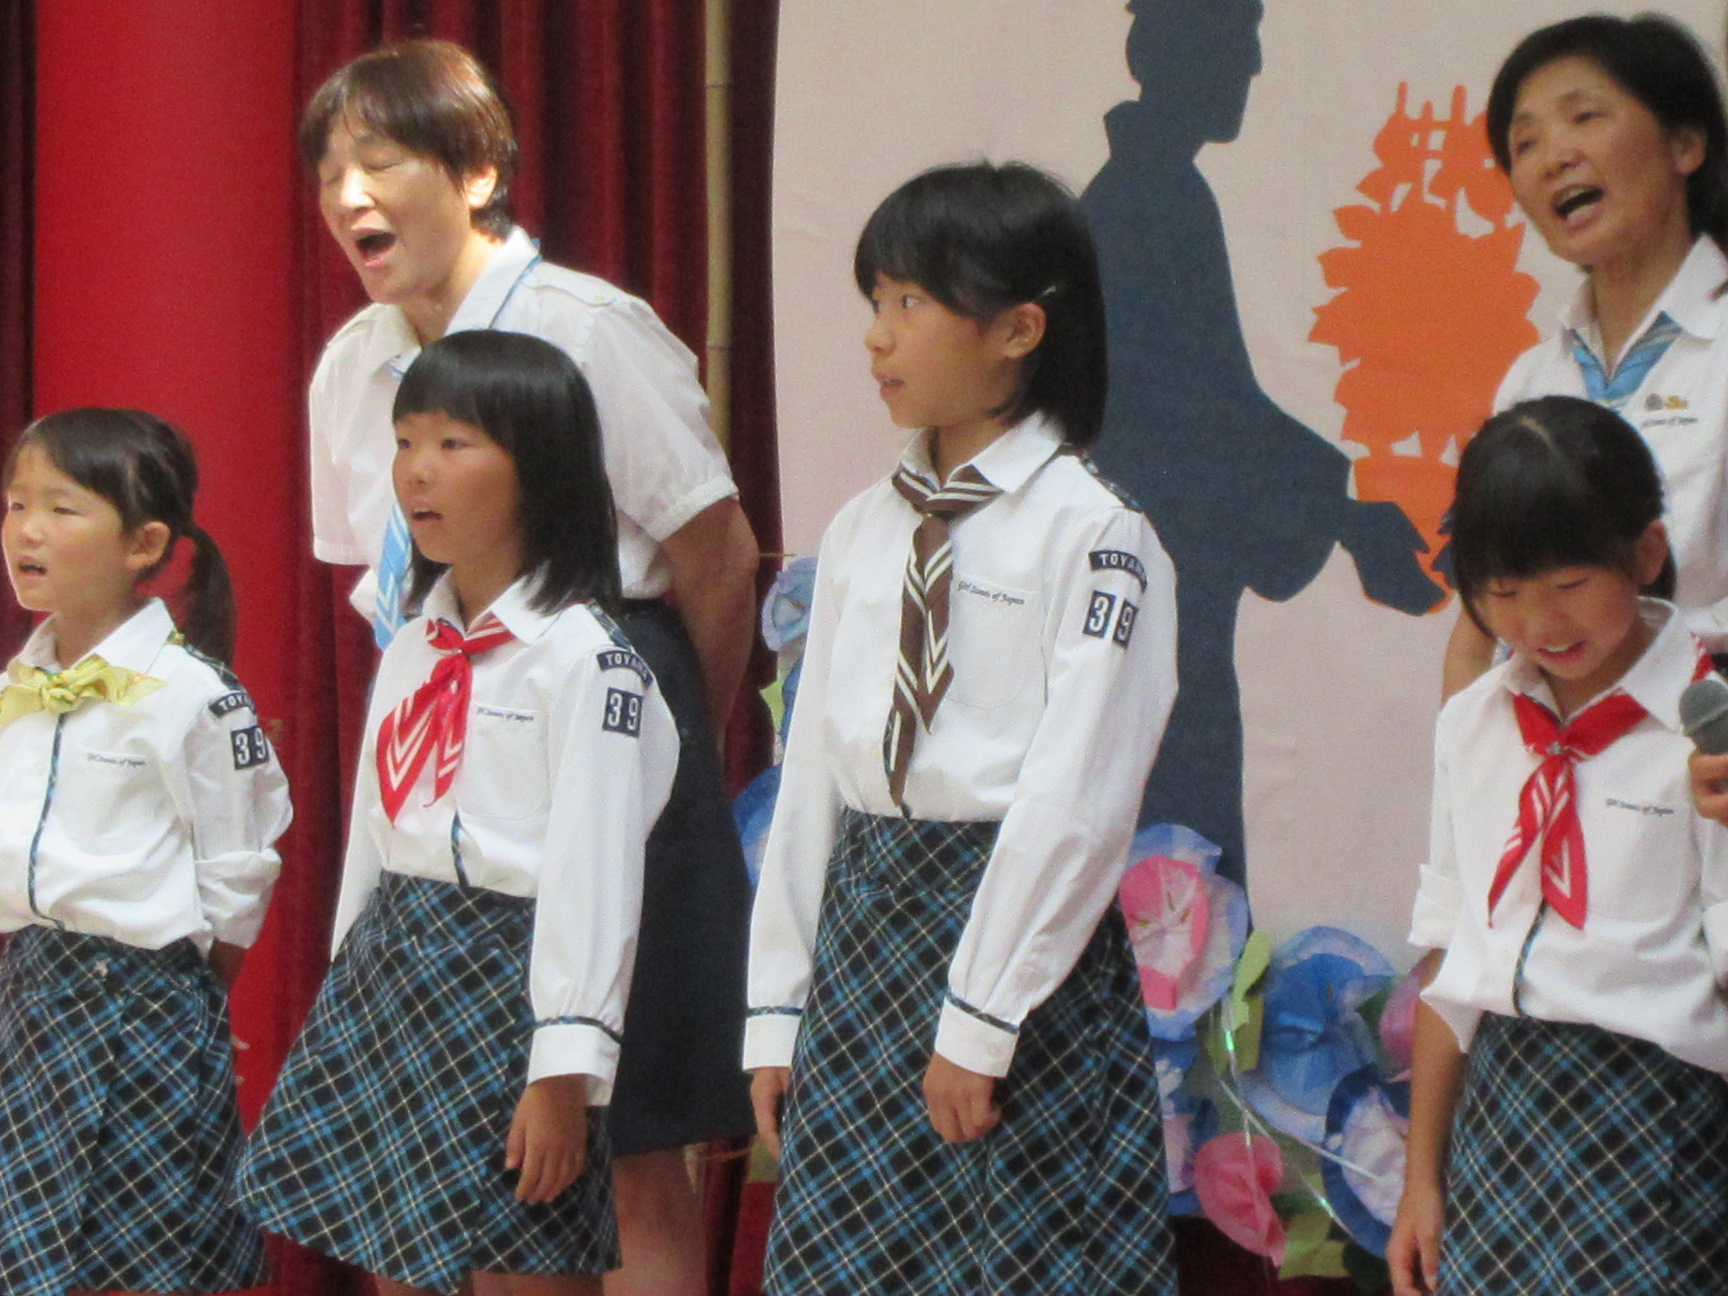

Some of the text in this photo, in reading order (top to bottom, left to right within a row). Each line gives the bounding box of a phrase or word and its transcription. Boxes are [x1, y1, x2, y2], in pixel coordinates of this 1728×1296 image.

[1088, 596, 1134, 642] 39
[607, 692, 640, 731] 39
[235, 727, 267, 765] 39
